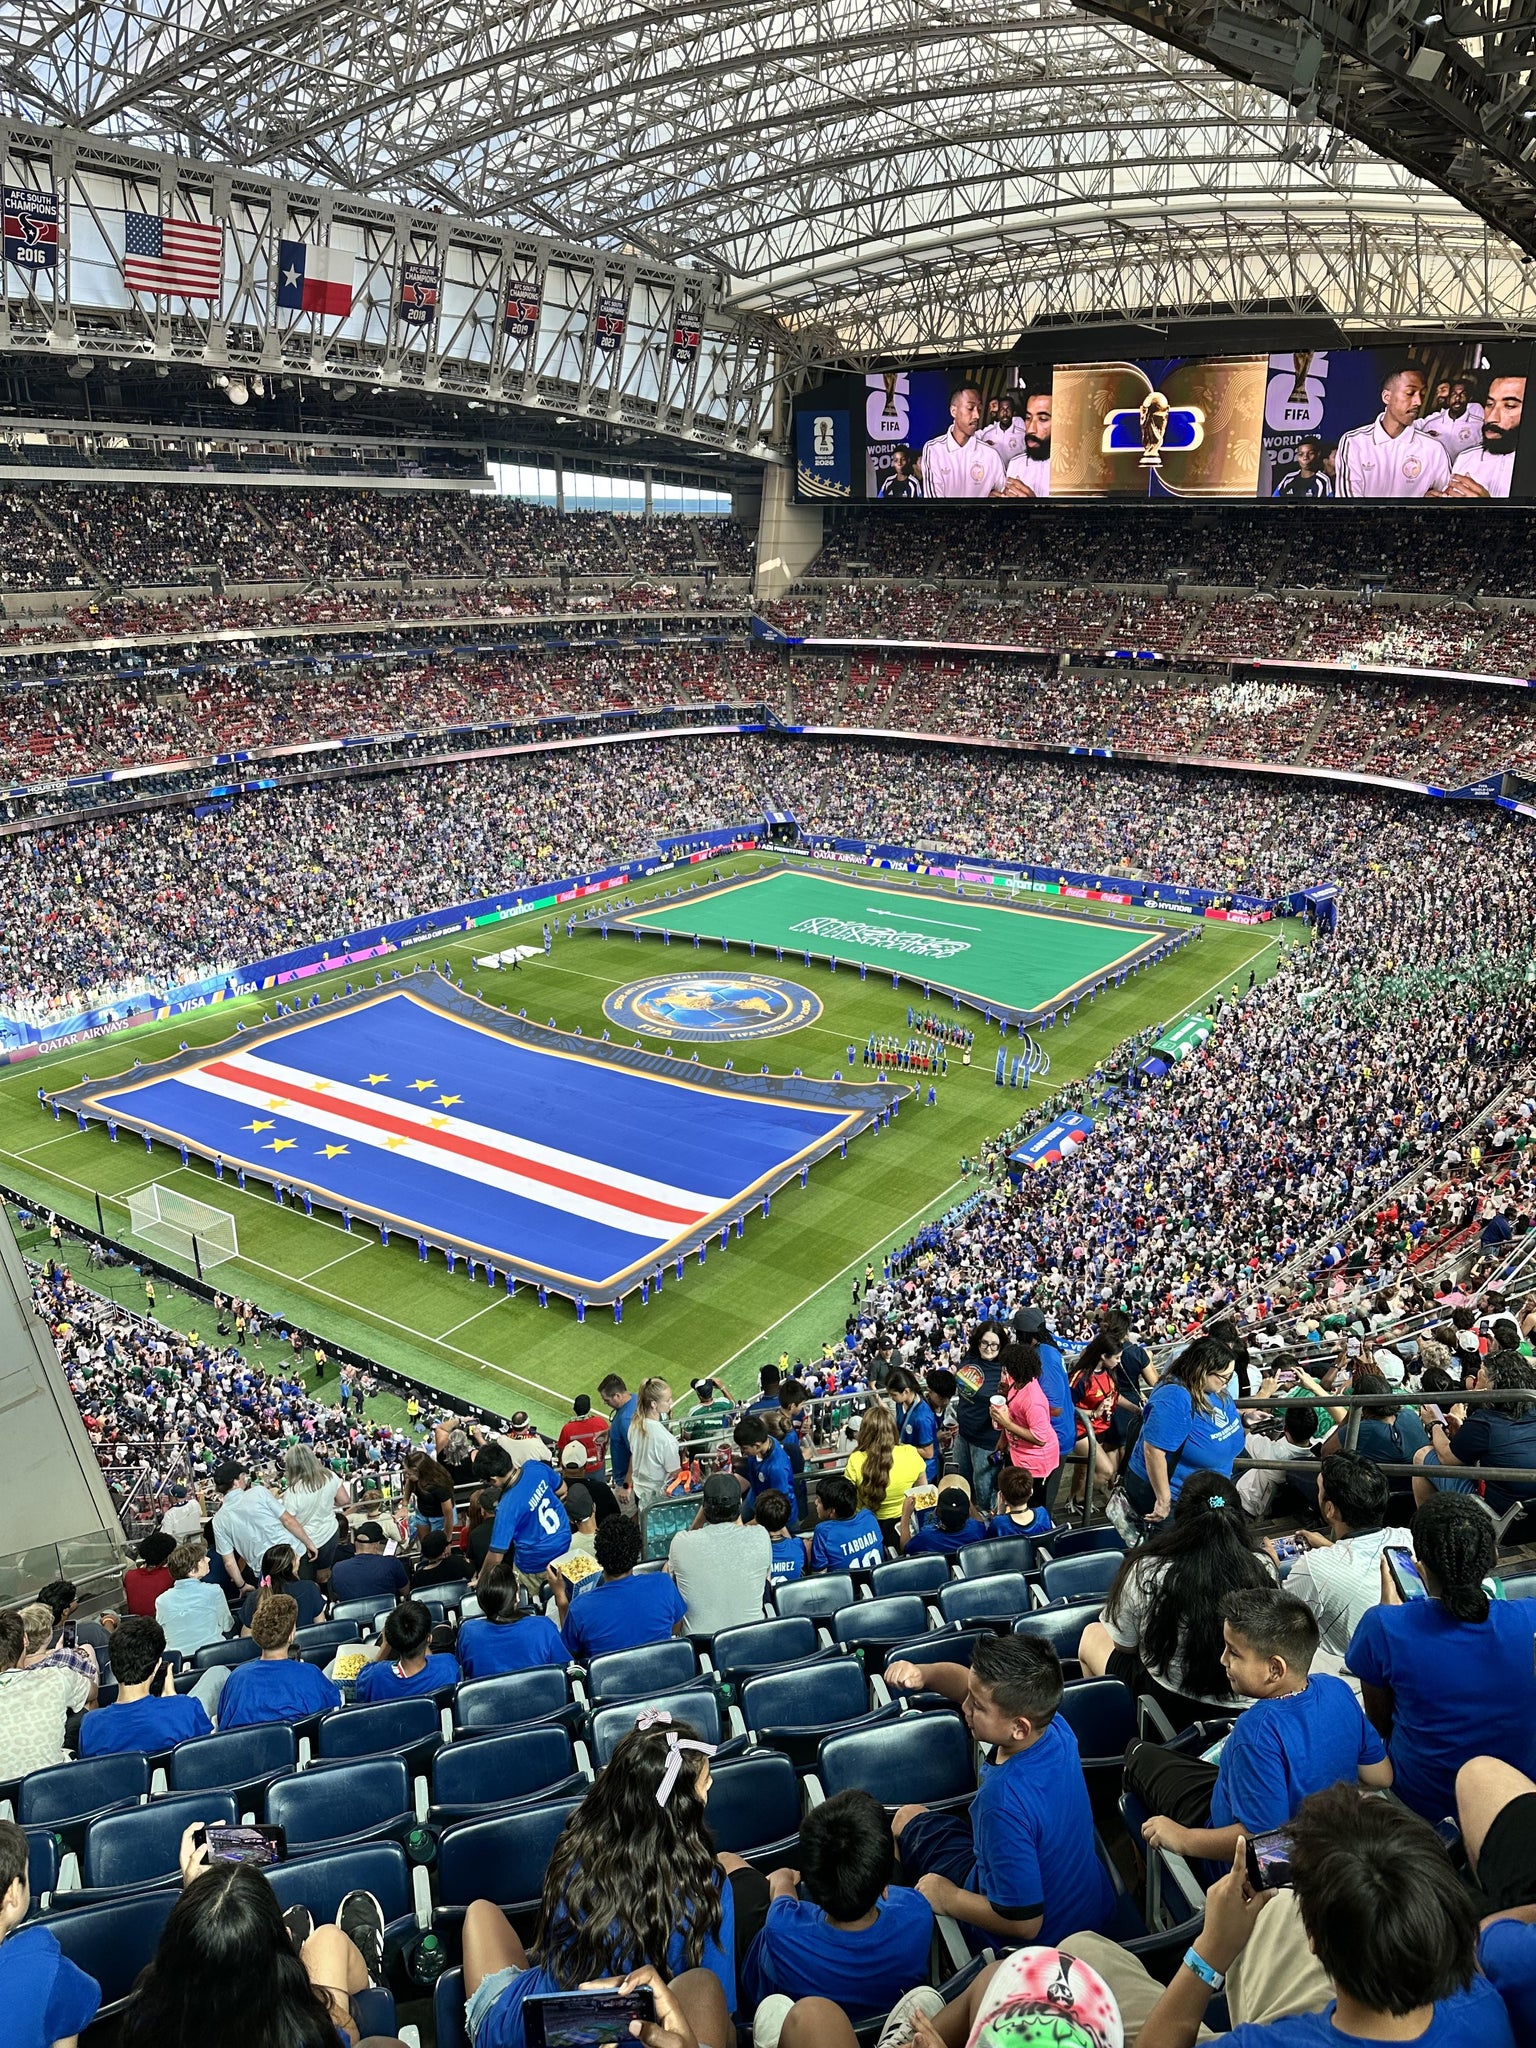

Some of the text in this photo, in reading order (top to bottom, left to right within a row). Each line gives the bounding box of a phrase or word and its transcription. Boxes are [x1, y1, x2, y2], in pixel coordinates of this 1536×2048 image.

[11, 191, 51, 204] AFC SOUTH
[5, 198, 56, 215] CHAMPIONS
[17, 247, 45, 263] 2016
[419, 267, 434, 275] SOUTH
[405, 272, 437, 283] CHAMPIONS
[510, 289, 539, 299] CHAMPIONS
[408, 309, 426, 320] 2018
[512, 324, 528, 334] 2019
[1284, 409, 1309, 420] FIFA
[881, 421, 900, 431] FIFA
[1263, 435, 1302, 447] WORLD
[867, 444, 896, 455] WORLD
[144, 668, 179, 676] HOUSTON
[27, 781, 68, 793] HOUSTON
[814, 851, 867, 864] QATAR AIRWAYS
[890, 861, 908, 872] VISA
[500, 903, 534, 919] aramco
[1159, 902, 1192, 913] HYUNDAI
[401, 938, 412, 947] FIFA
[232, 981, 258, 997] VISA
[177, 997, 207, 1012] VISA
[637, 1024, 672, 1036] FIFA
[38, 1019, 129, 1054] QATAR AIRWAYS
[528, 1479, 549, 1512] JUAREZ
[538, 1498, 560, 1534] 6
[840, 1530, 878, 1556] TABOADA
[771, 1561, 795, 1573] AMIREZ
